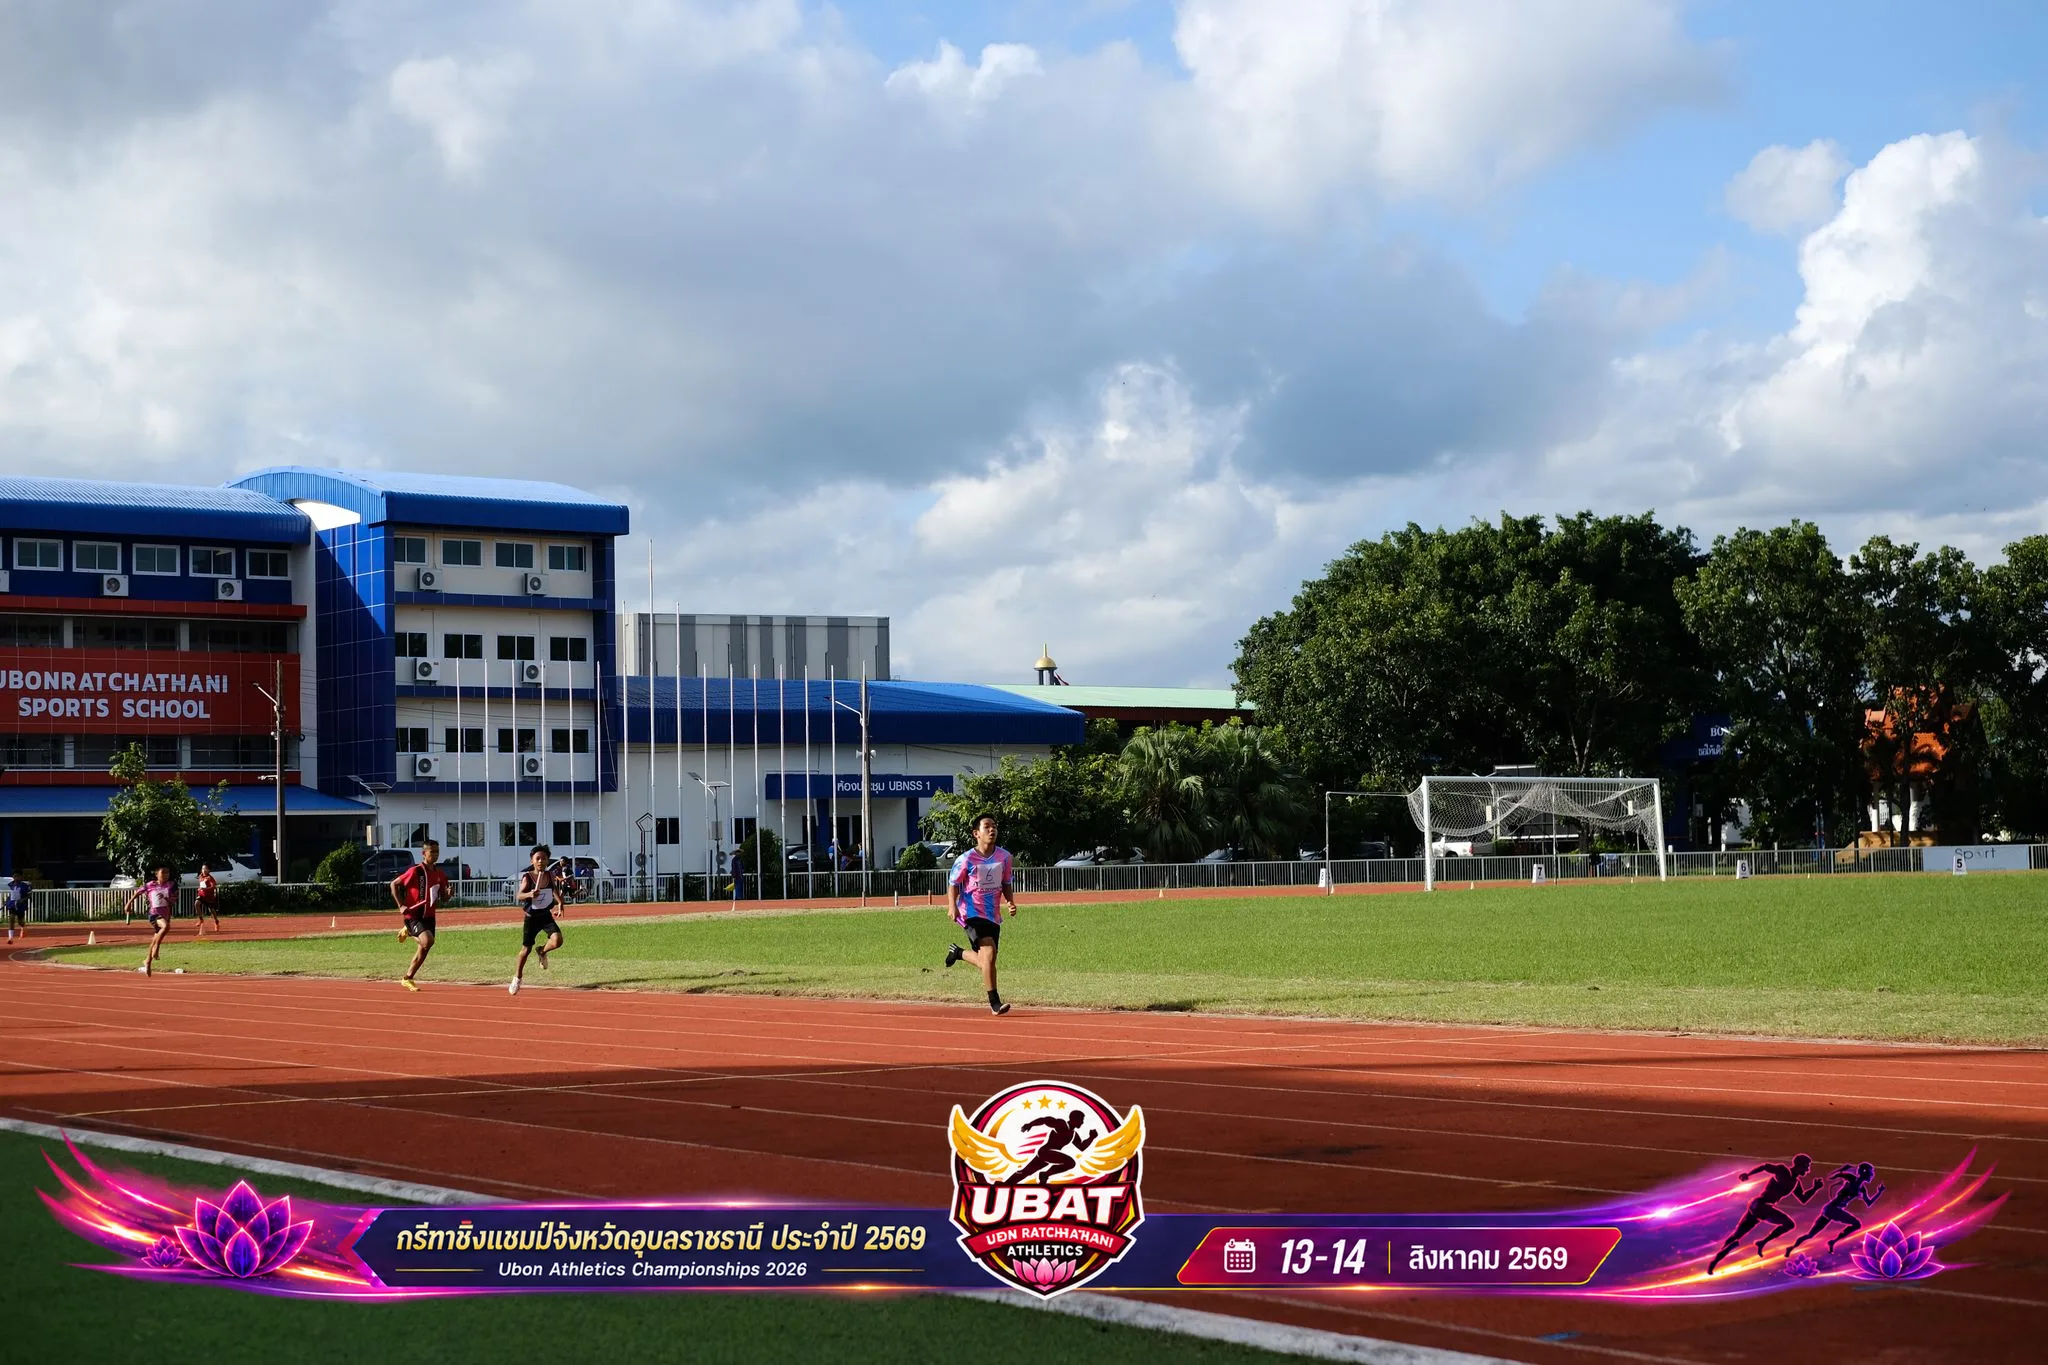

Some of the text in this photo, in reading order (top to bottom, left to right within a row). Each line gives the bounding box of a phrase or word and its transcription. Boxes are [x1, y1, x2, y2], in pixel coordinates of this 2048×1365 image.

[19, 697, 210, 718] SPORTS SCHOOL
[888, 781, 923, 791] UBNSS
[926, 781, 931, 791] 1
[1740, 862, 1747, 872] 6
[1956, 858, 1963, 869] 5
[985, 867, 994, 882] 6
[1537, 866, 1543, 876] 7
